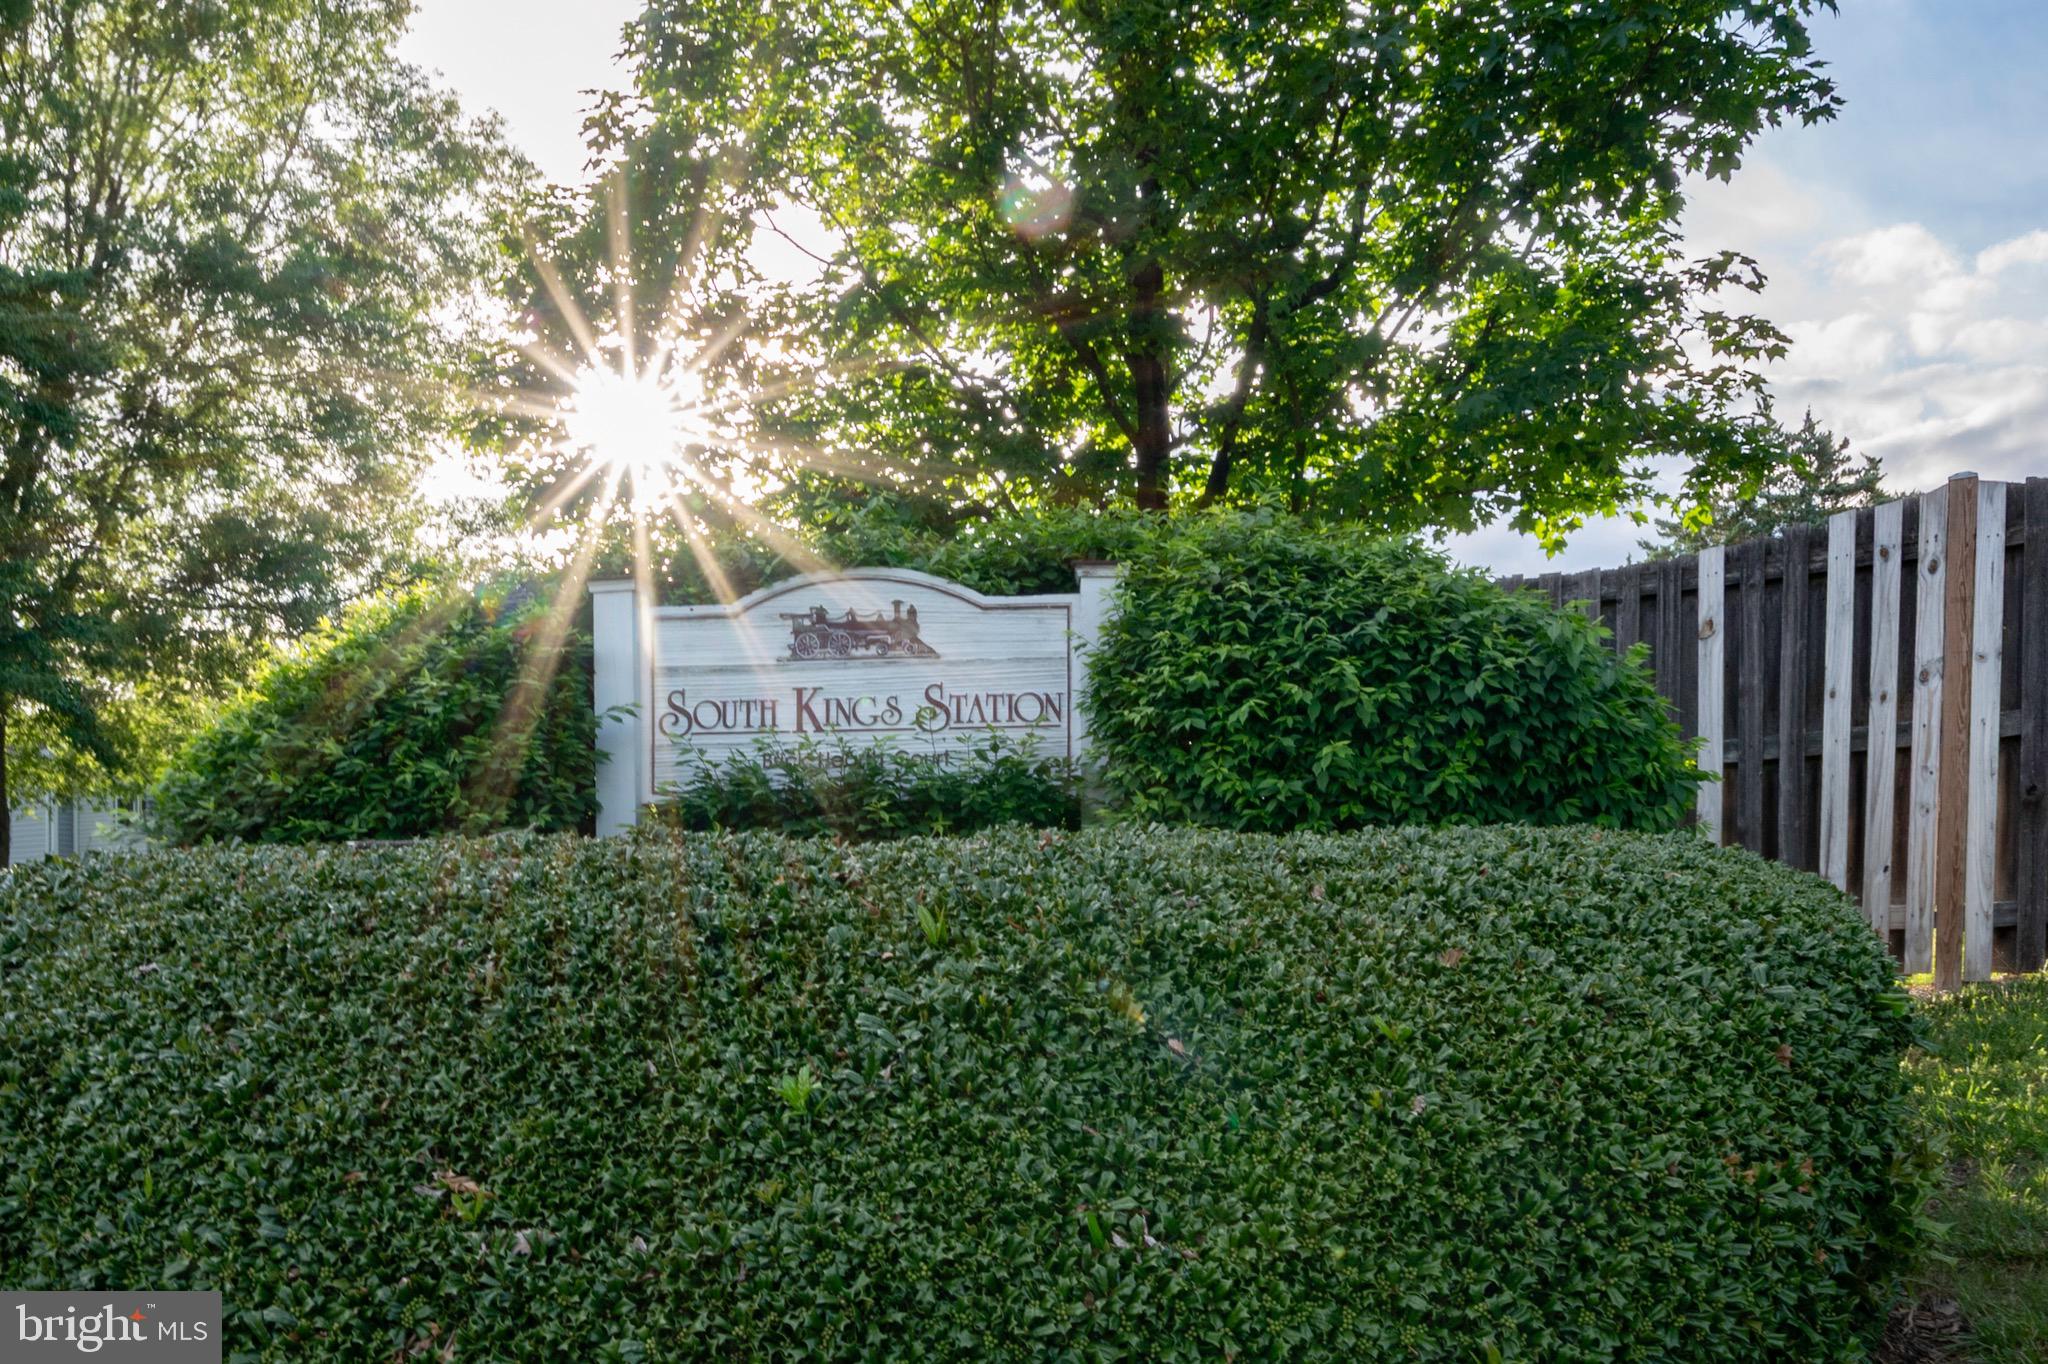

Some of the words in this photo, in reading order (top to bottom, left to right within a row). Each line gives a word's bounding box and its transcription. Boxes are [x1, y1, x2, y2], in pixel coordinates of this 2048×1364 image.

[658, 687, 779, 739] SOUTH
[792, 686, 903, 733] KINGS
[915, 681, 1064, 733] STATION
